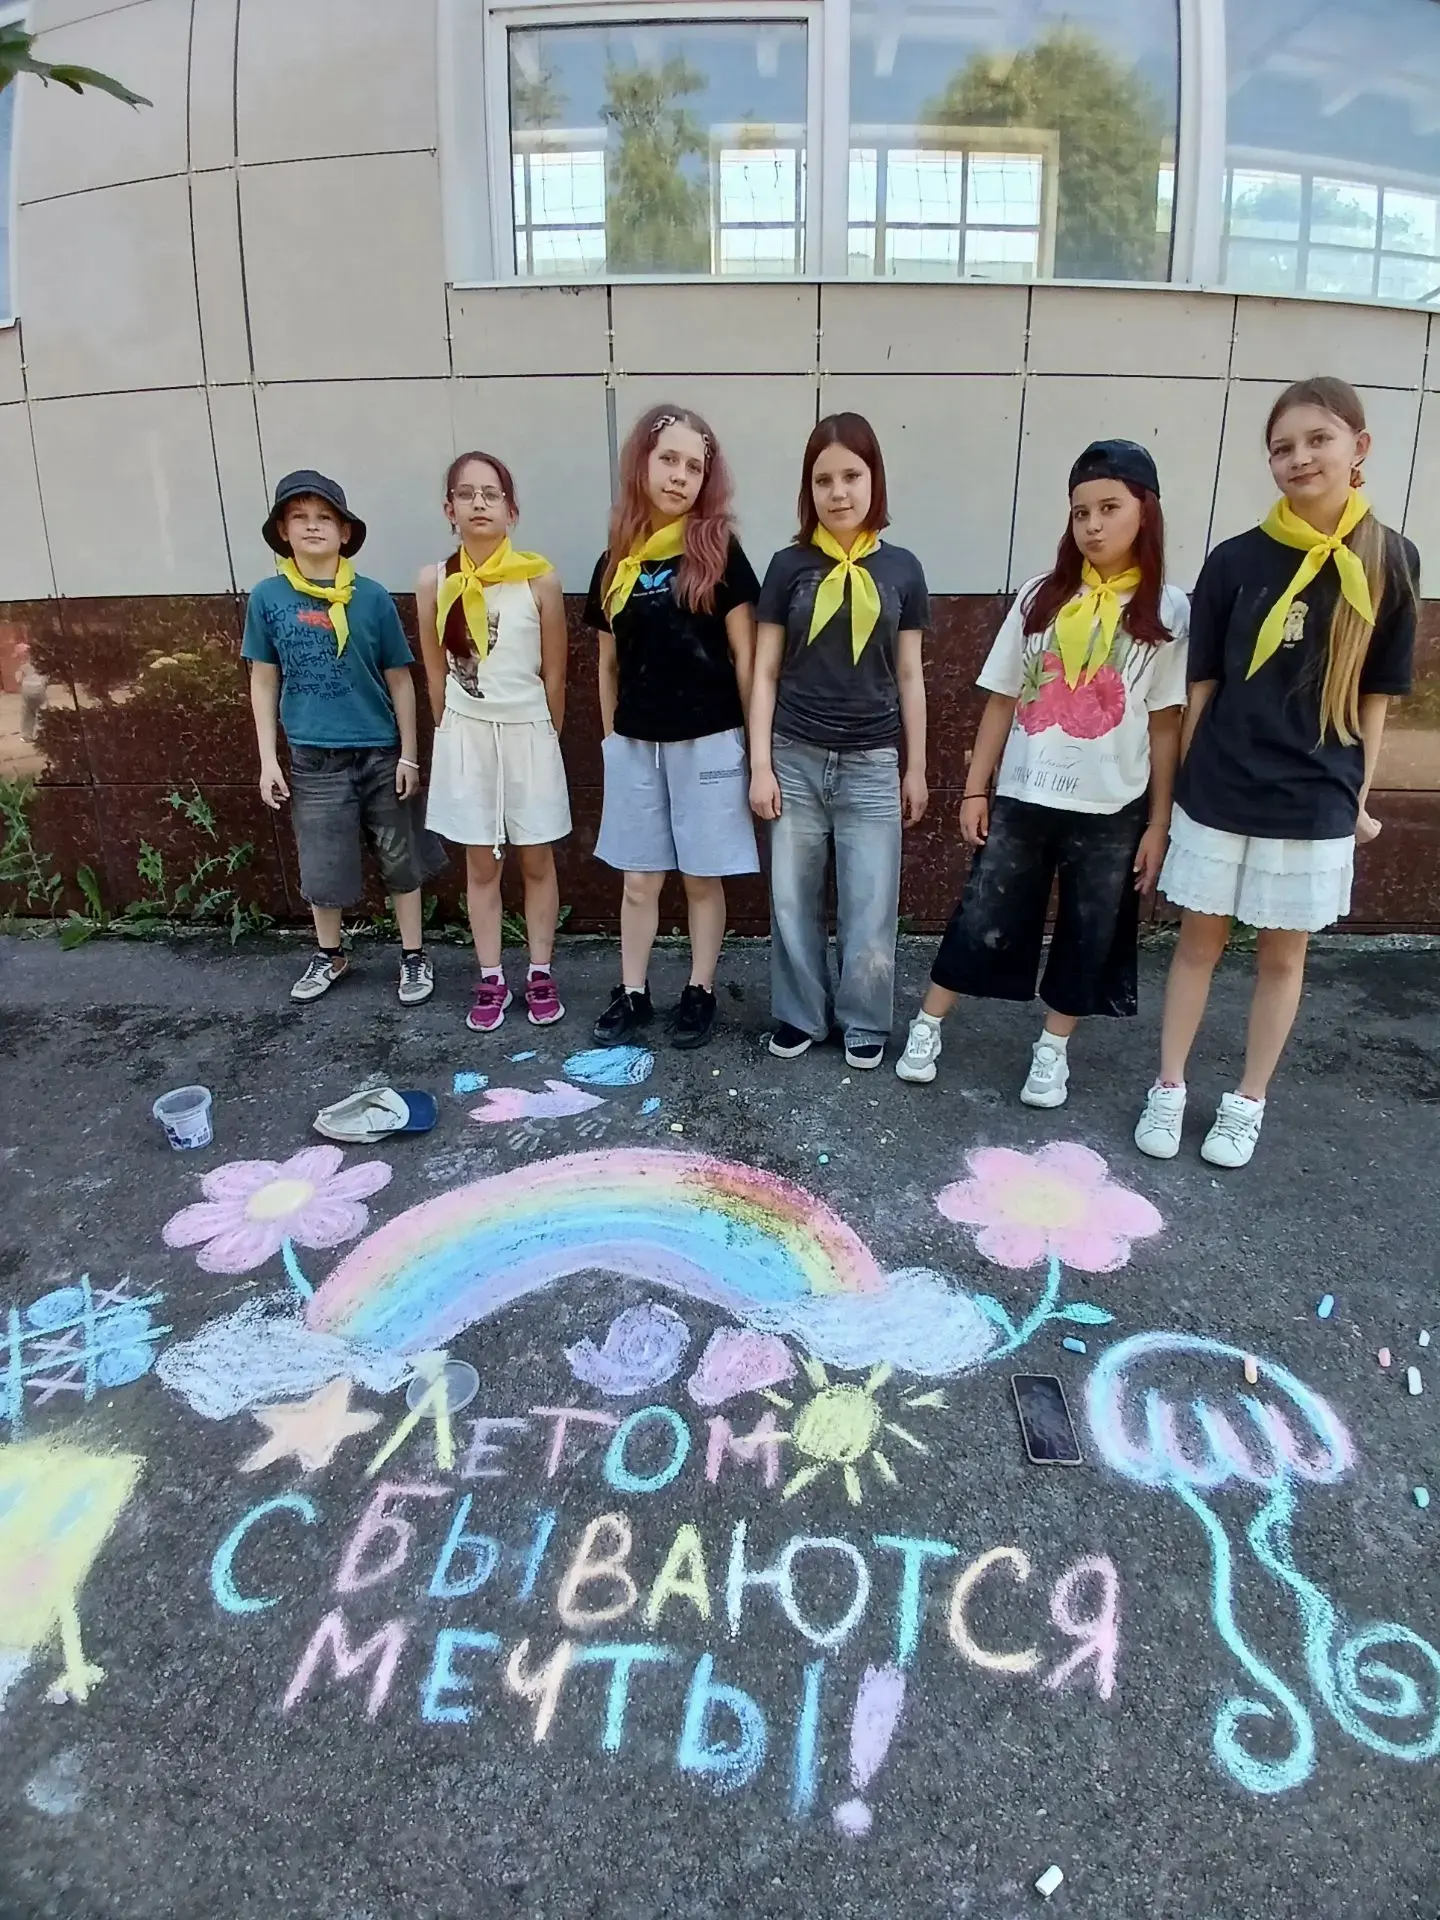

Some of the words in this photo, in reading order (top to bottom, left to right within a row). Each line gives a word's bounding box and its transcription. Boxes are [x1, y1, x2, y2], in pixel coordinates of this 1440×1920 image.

[364, 1351, 784, 1493] ЛЕТОМ
[209, 1482, 1121, 1701] СБЫВАЮТСЯ
[282, 1605, 906, 1838] МЕЧТЫ!
